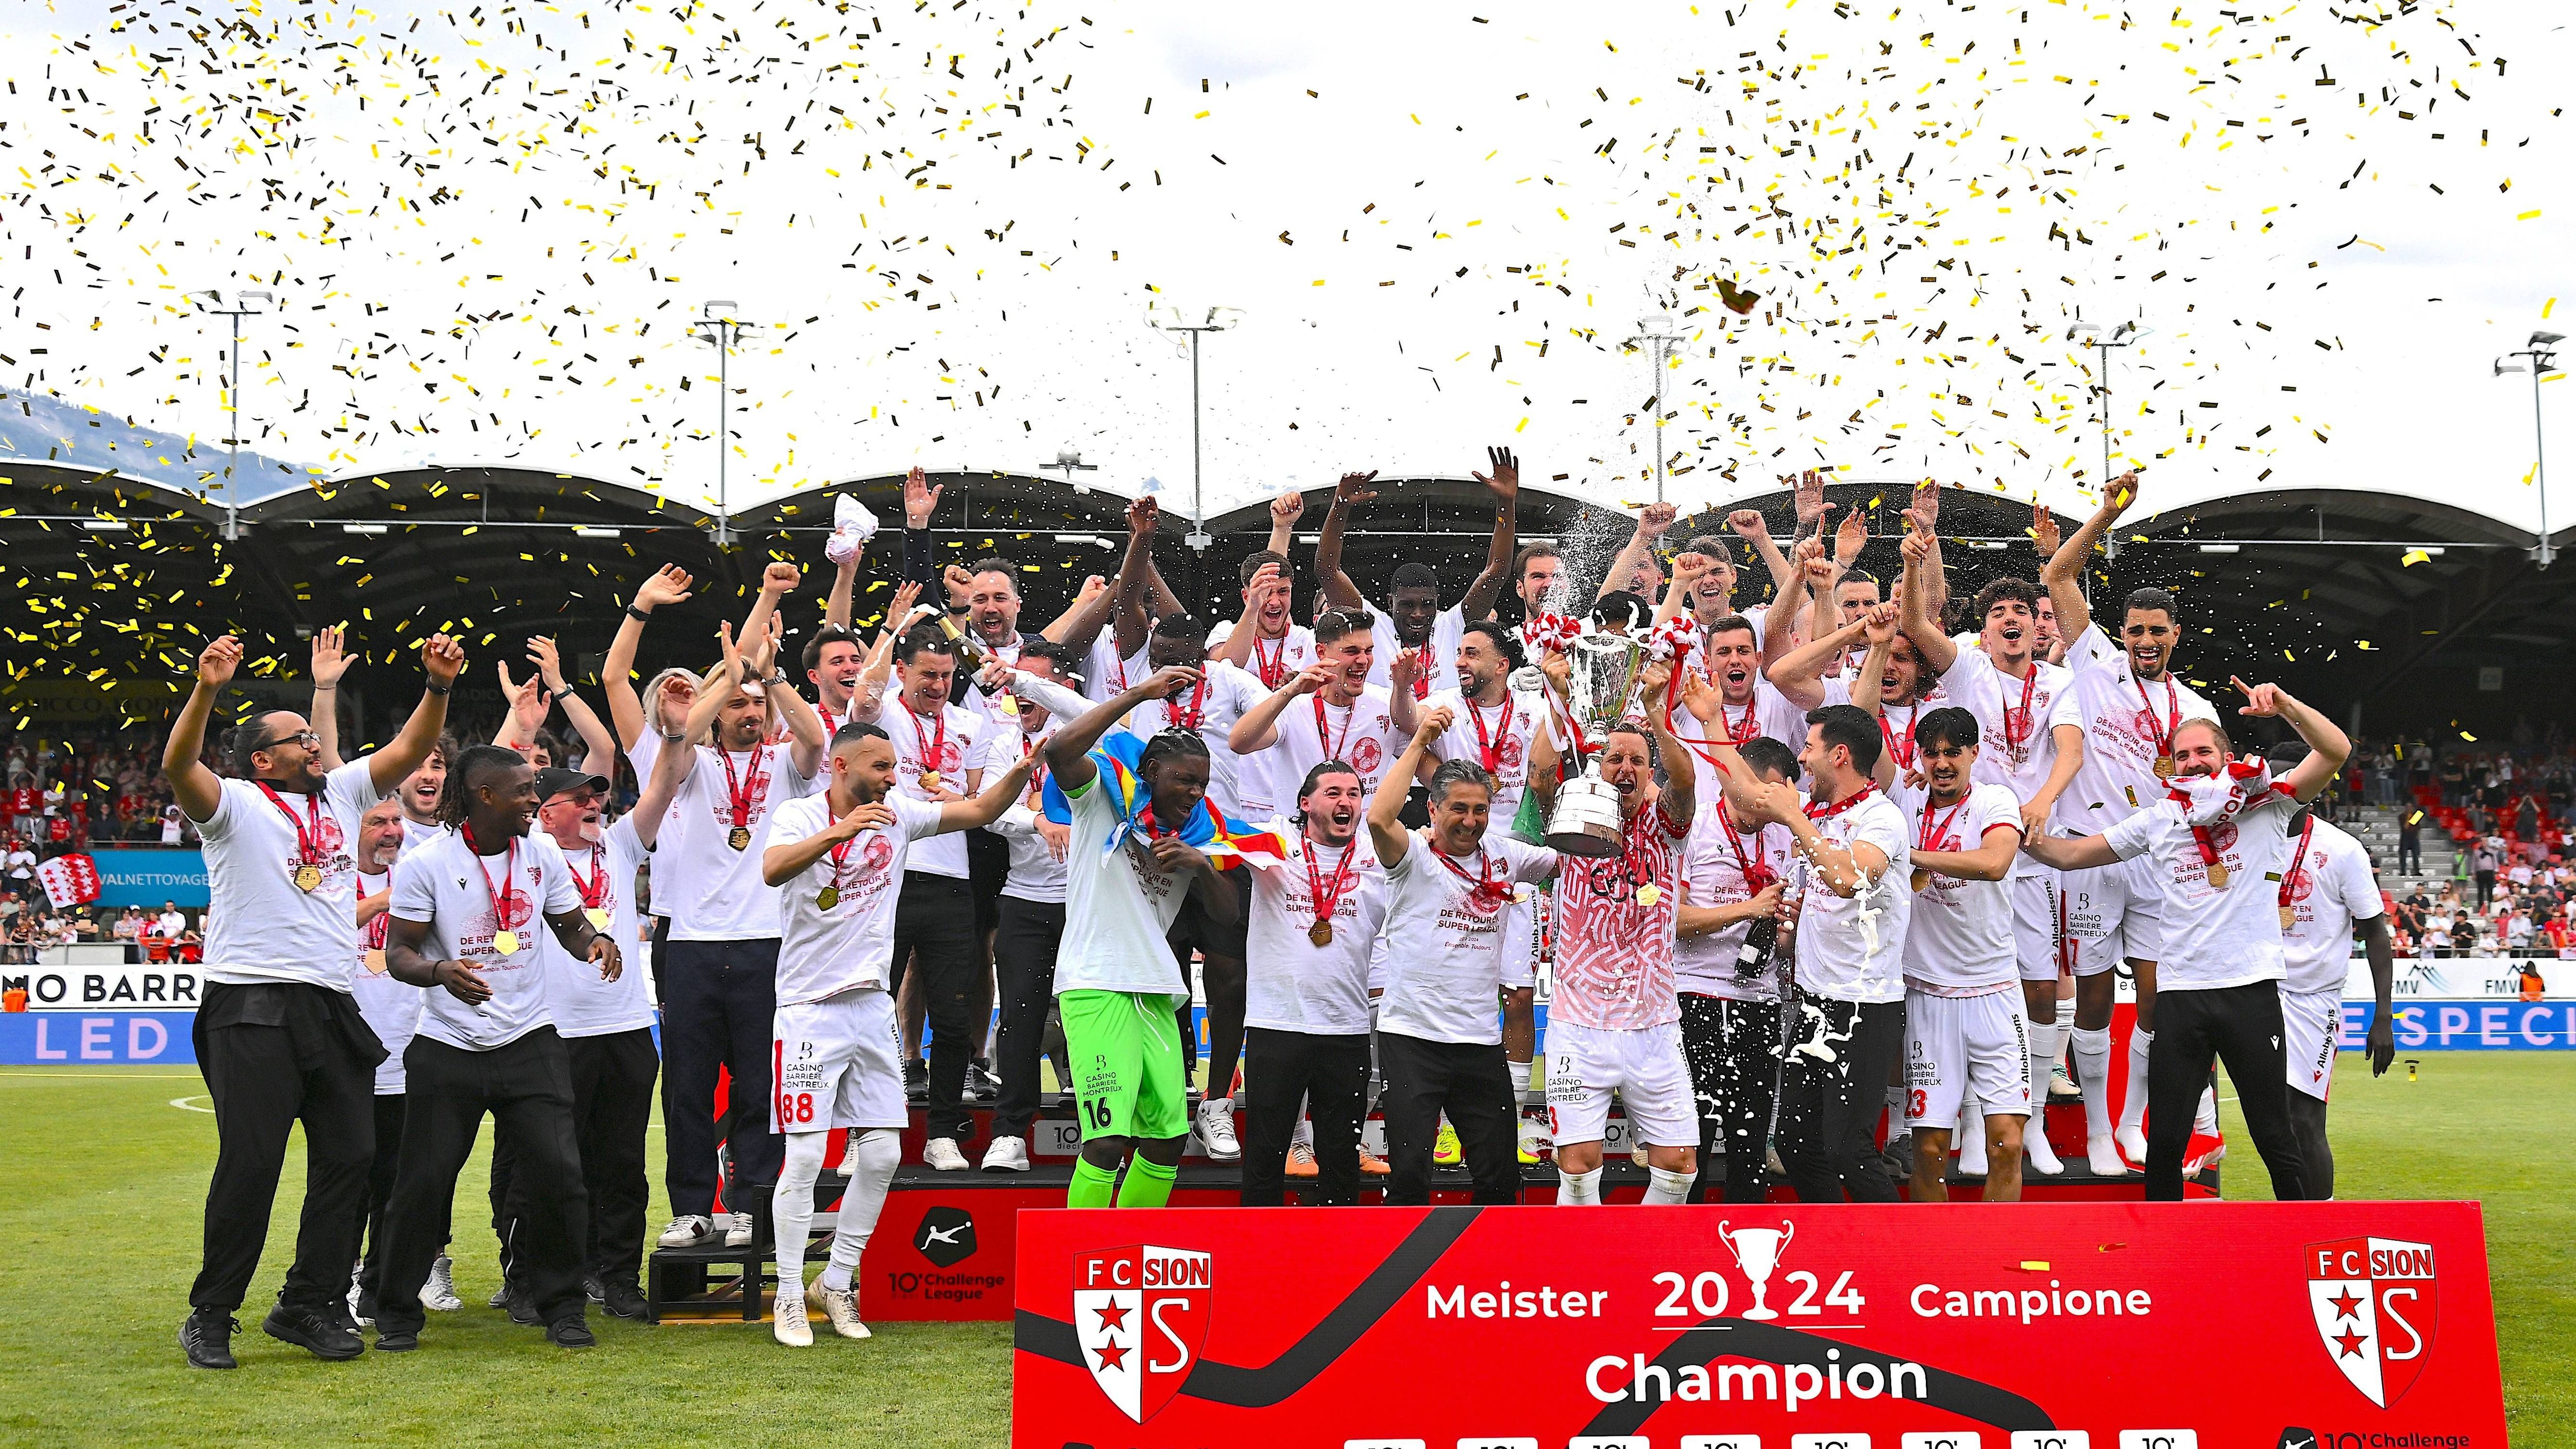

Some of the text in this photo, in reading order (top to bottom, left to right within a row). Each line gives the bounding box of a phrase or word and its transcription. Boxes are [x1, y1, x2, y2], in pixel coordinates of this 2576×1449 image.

[2096, 717, 2152, 755] DE RETOUR EN
[2092, 726, 2149, 762] SUPER LEAGUE
[900, 767, 924, 776] SUPE
[1369, 776, 1379, 785] EN
[2174, 853, 2239, 873] DE EN
[2175, 863, 2243, 883] SUPER GUE
[845, 875, 881, 890] RETOUR
[1161, 877, 1173, 888] EN
[1331, 909, 1357, 917] AGUE
[1440, 909, 1453, 917] DE
[1455, 911, 1493, 924] RETOUR
[2045, 880, 2059, 949] Alloboissons
[2070, 913, 2102, 922] CASINO
[1438, 920, 1469, 931] SUPER
[460, 946, 495, 956] SUPER
[2486, 980, 2517, 994] FMV
[36, 1018, 168, 1060] LED
[2014, 1013, 2029, 1084] Alloboissons
[786, 1064, 823, 1072] CASINO
[1086, 1072, 1116, 1083] CASINO
[1548, 1078, 1582, 1086] CASINO
[1083, 1086, 1122, 1097] MONTREUX
[1547, 1093, 1588, 1102] MONTREUX
[783, 1093, 815, 1124] 88
[1905, 1089, 1927, 1119] 23
[1083, 1097, 1113, 1132] 16
[2371, 1249, 2433, 1277] SION
[1145, 1259, 1210, 1286] SION
[888, 1272, 1005, 1293] 10' Challenge
[925, 1289, 983, 1303] League
[1428, 1281, 1607, 1319] Meister
[1910, 1280, 2151, 1325] Campione
[1585, 1348, 1928, 1412] Champion
[2370, 1433, 2470, 1449] Challenge
